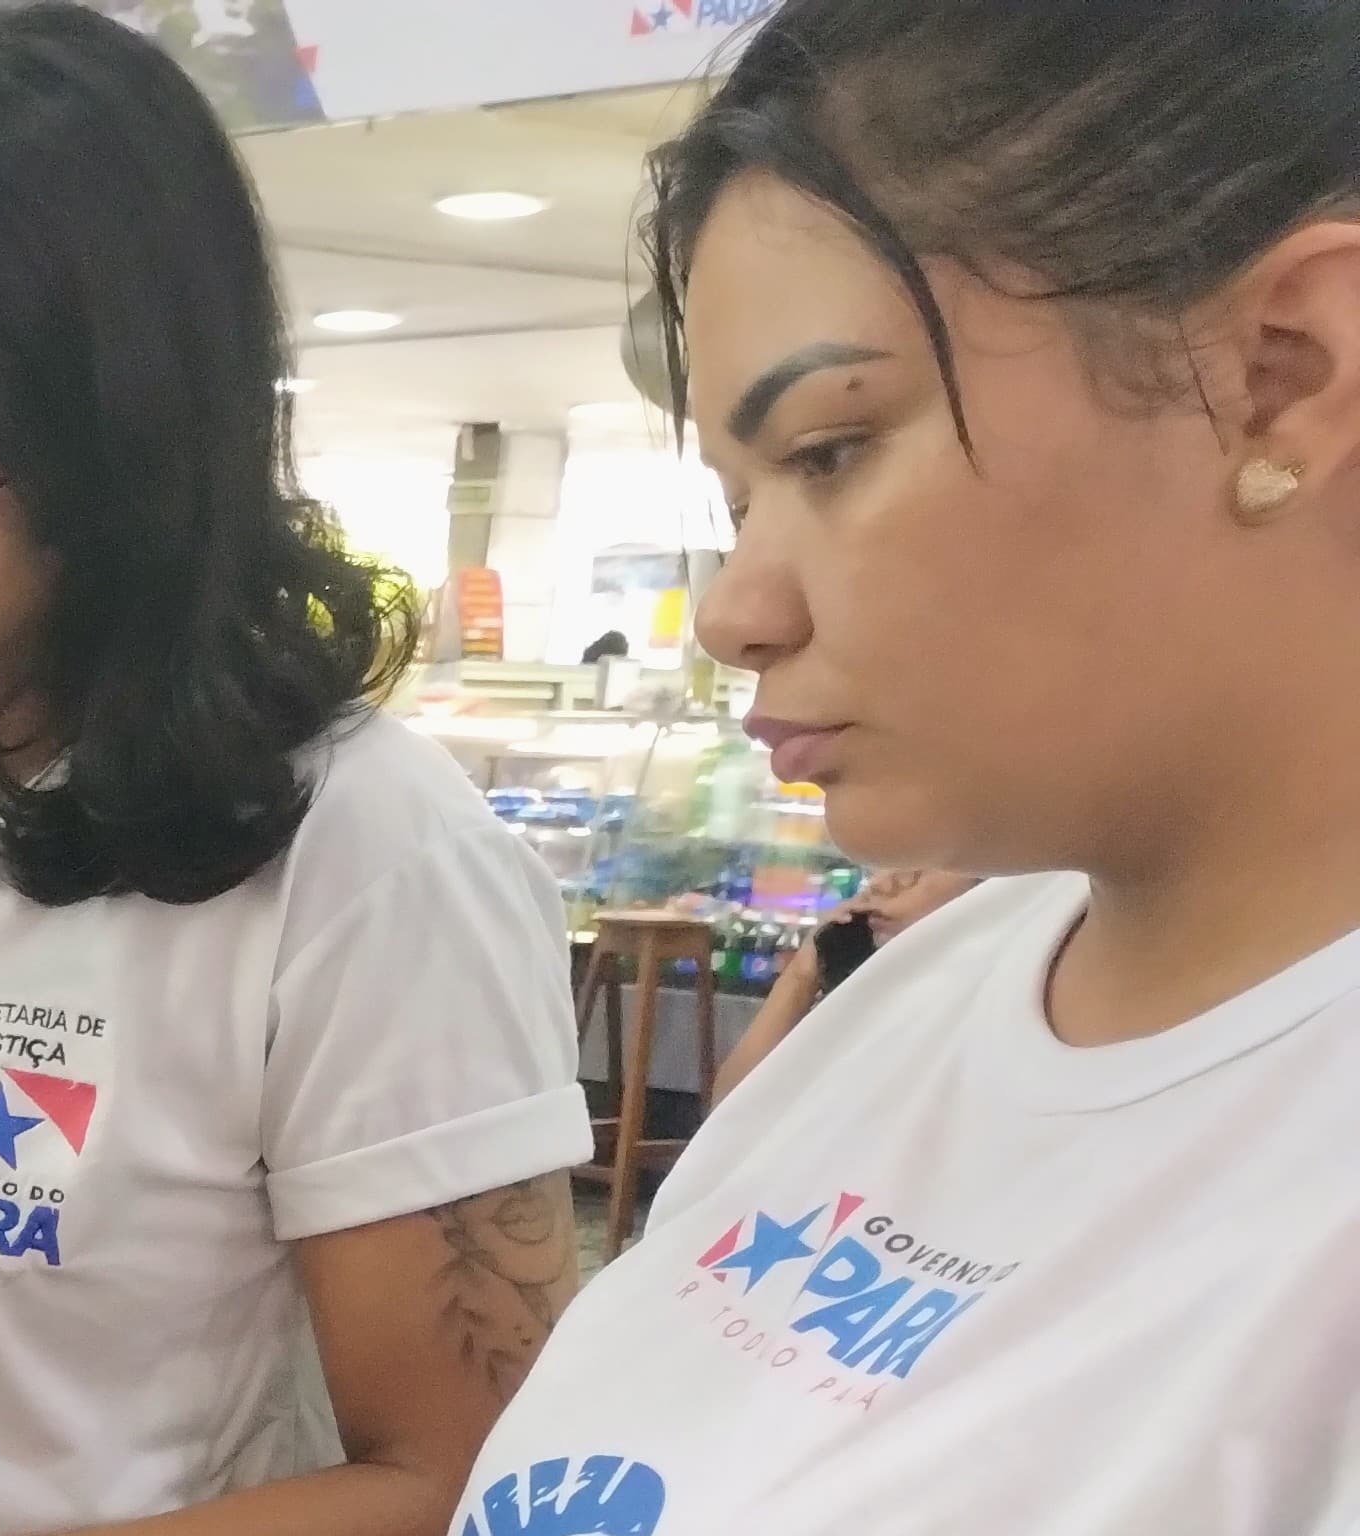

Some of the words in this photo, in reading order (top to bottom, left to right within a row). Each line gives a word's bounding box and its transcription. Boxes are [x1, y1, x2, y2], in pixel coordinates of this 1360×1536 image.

[76, 1014, 107, 1038] DE
[30, 1185, 65, 1204] DO
[863, 1215, 992, 1286] GOVERNO
